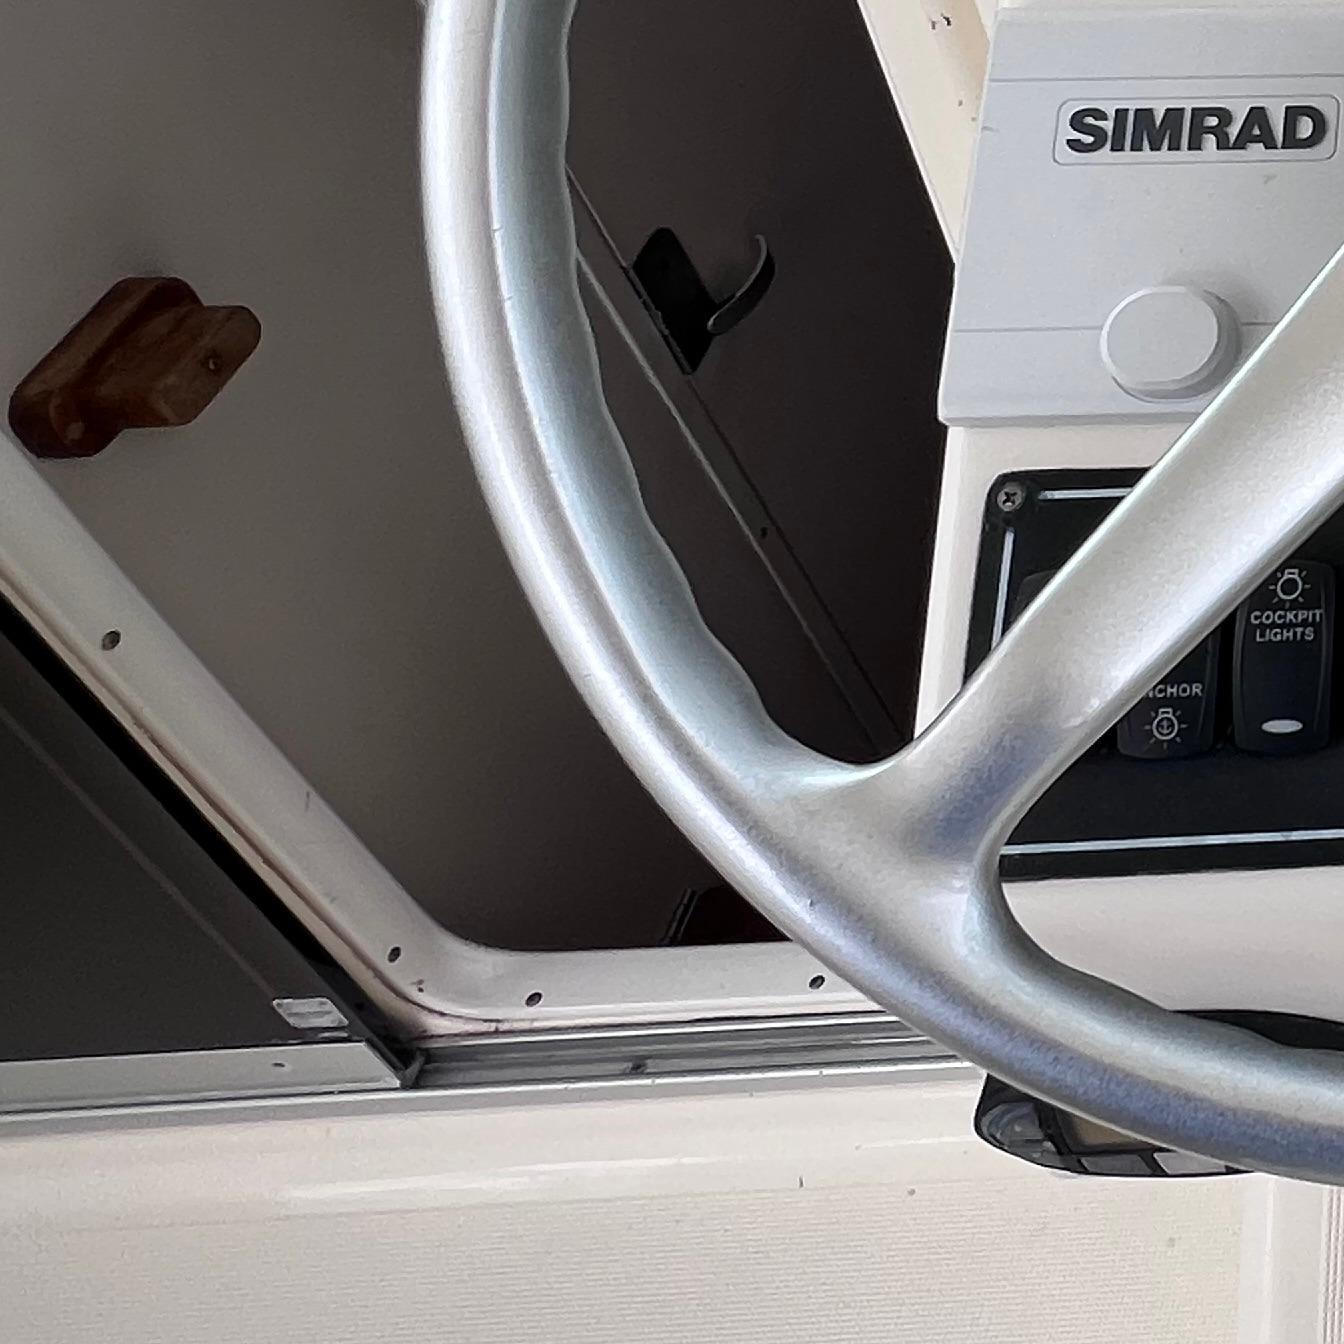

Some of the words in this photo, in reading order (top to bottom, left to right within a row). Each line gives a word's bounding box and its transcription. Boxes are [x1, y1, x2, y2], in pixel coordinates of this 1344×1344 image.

[1065, 105, 1328, 154] SIMRAD
[1250, 609, 1324, 625] COCKPIT
[1255, 626, 1315, 642] LIGHTS
